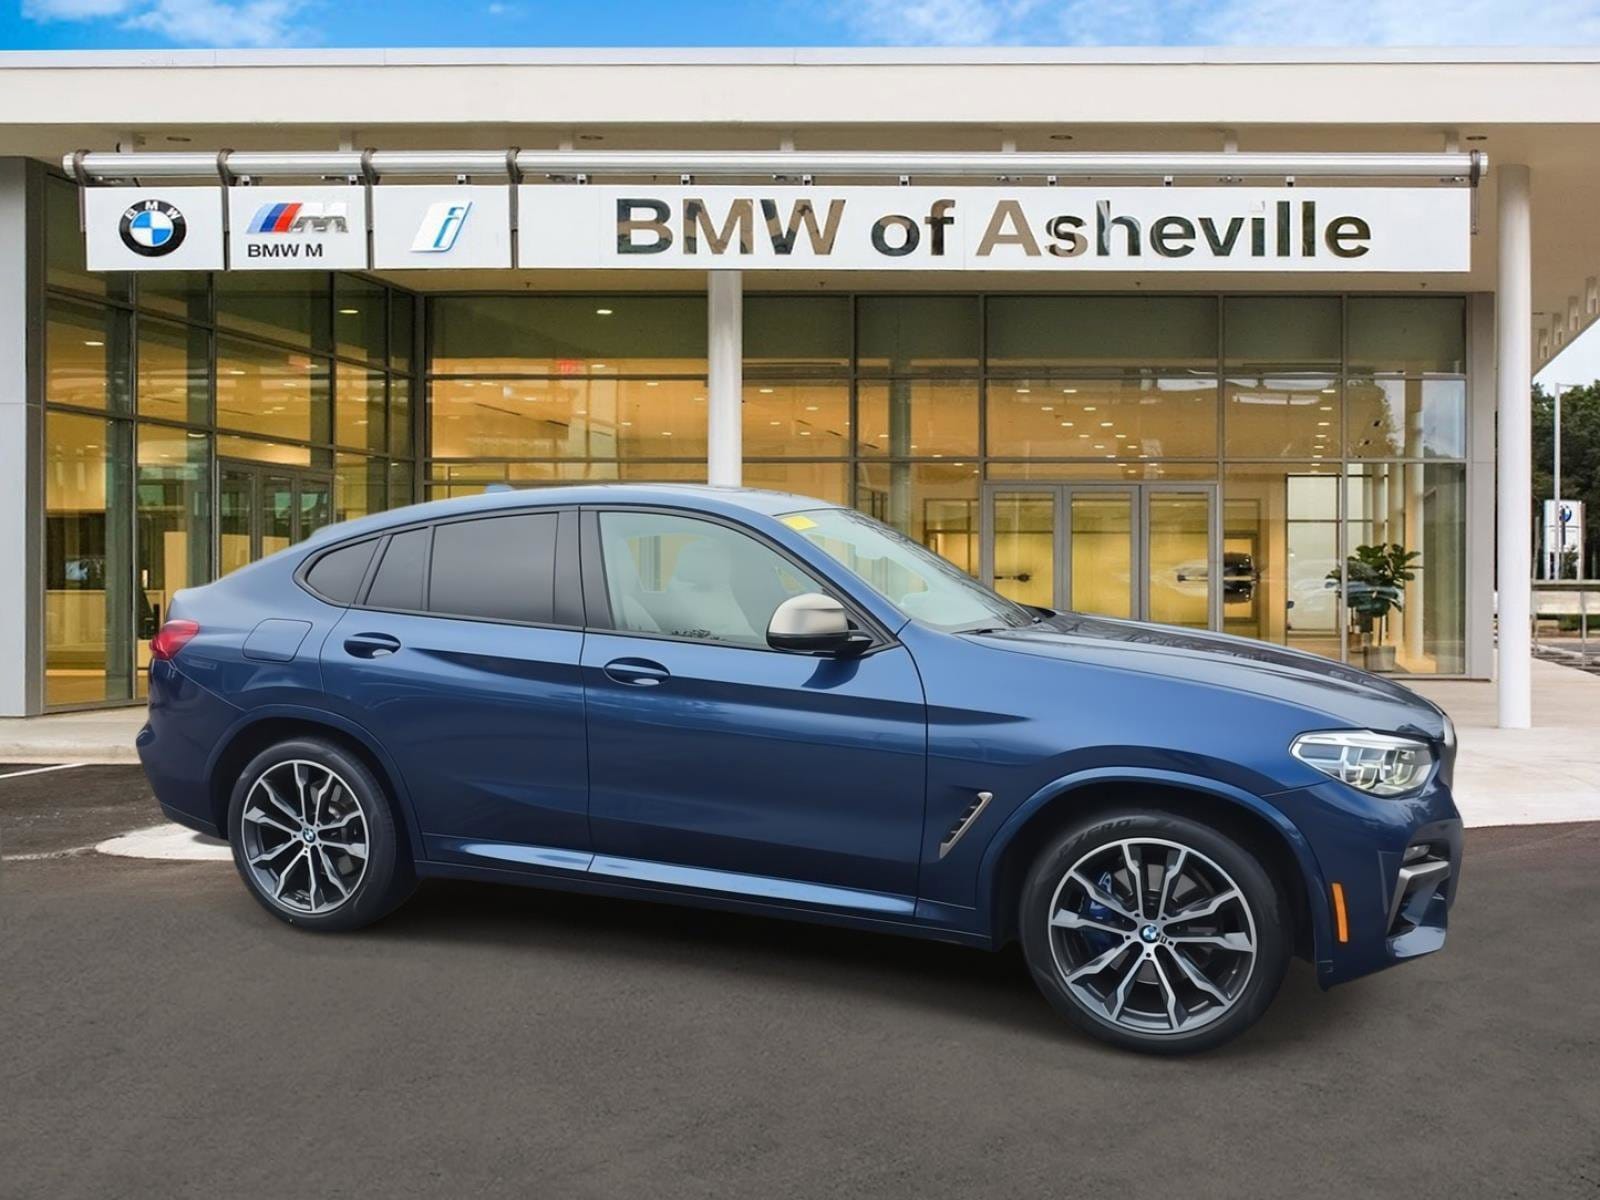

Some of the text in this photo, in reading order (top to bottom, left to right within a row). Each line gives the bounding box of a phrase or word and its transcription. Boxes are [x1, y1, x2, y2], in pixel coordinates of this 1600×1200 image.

[615, 198, 1372, 259] BMW of Asheville
[247, 243, 323, 258] BMW M
